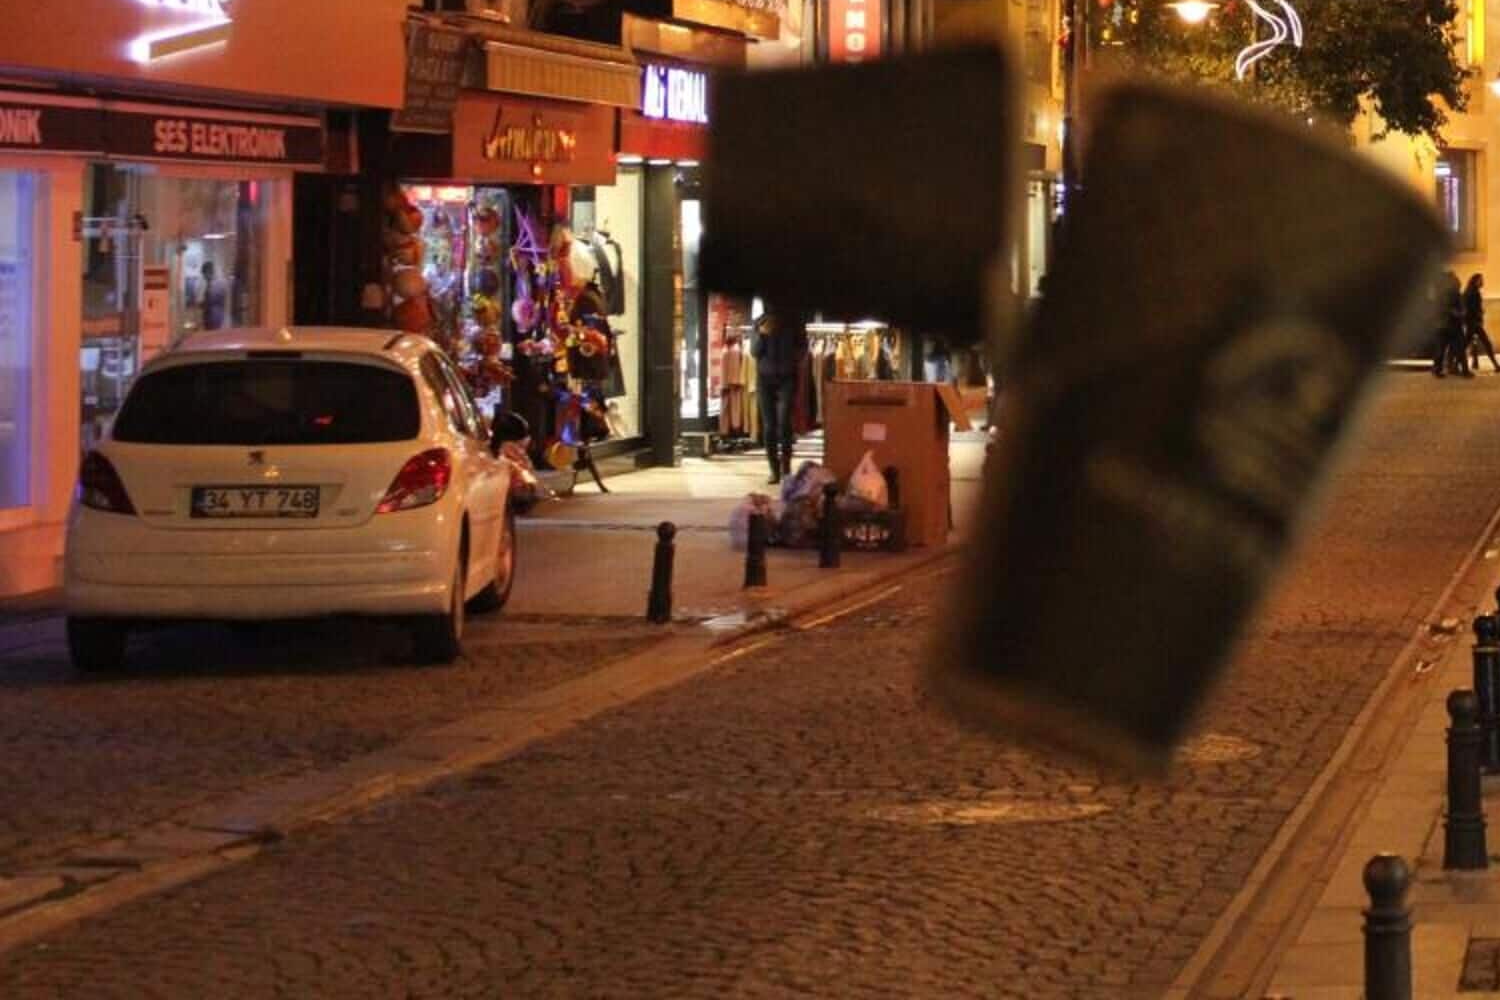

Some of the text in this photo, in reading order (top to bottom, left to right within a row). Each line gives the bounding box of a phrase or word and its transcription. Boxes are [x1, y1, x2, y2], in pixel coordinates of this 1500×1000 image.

[154, 119, 188, 152] SES
[207, 491, 229, 509] 34
[239, 492, 268, 509] YT
